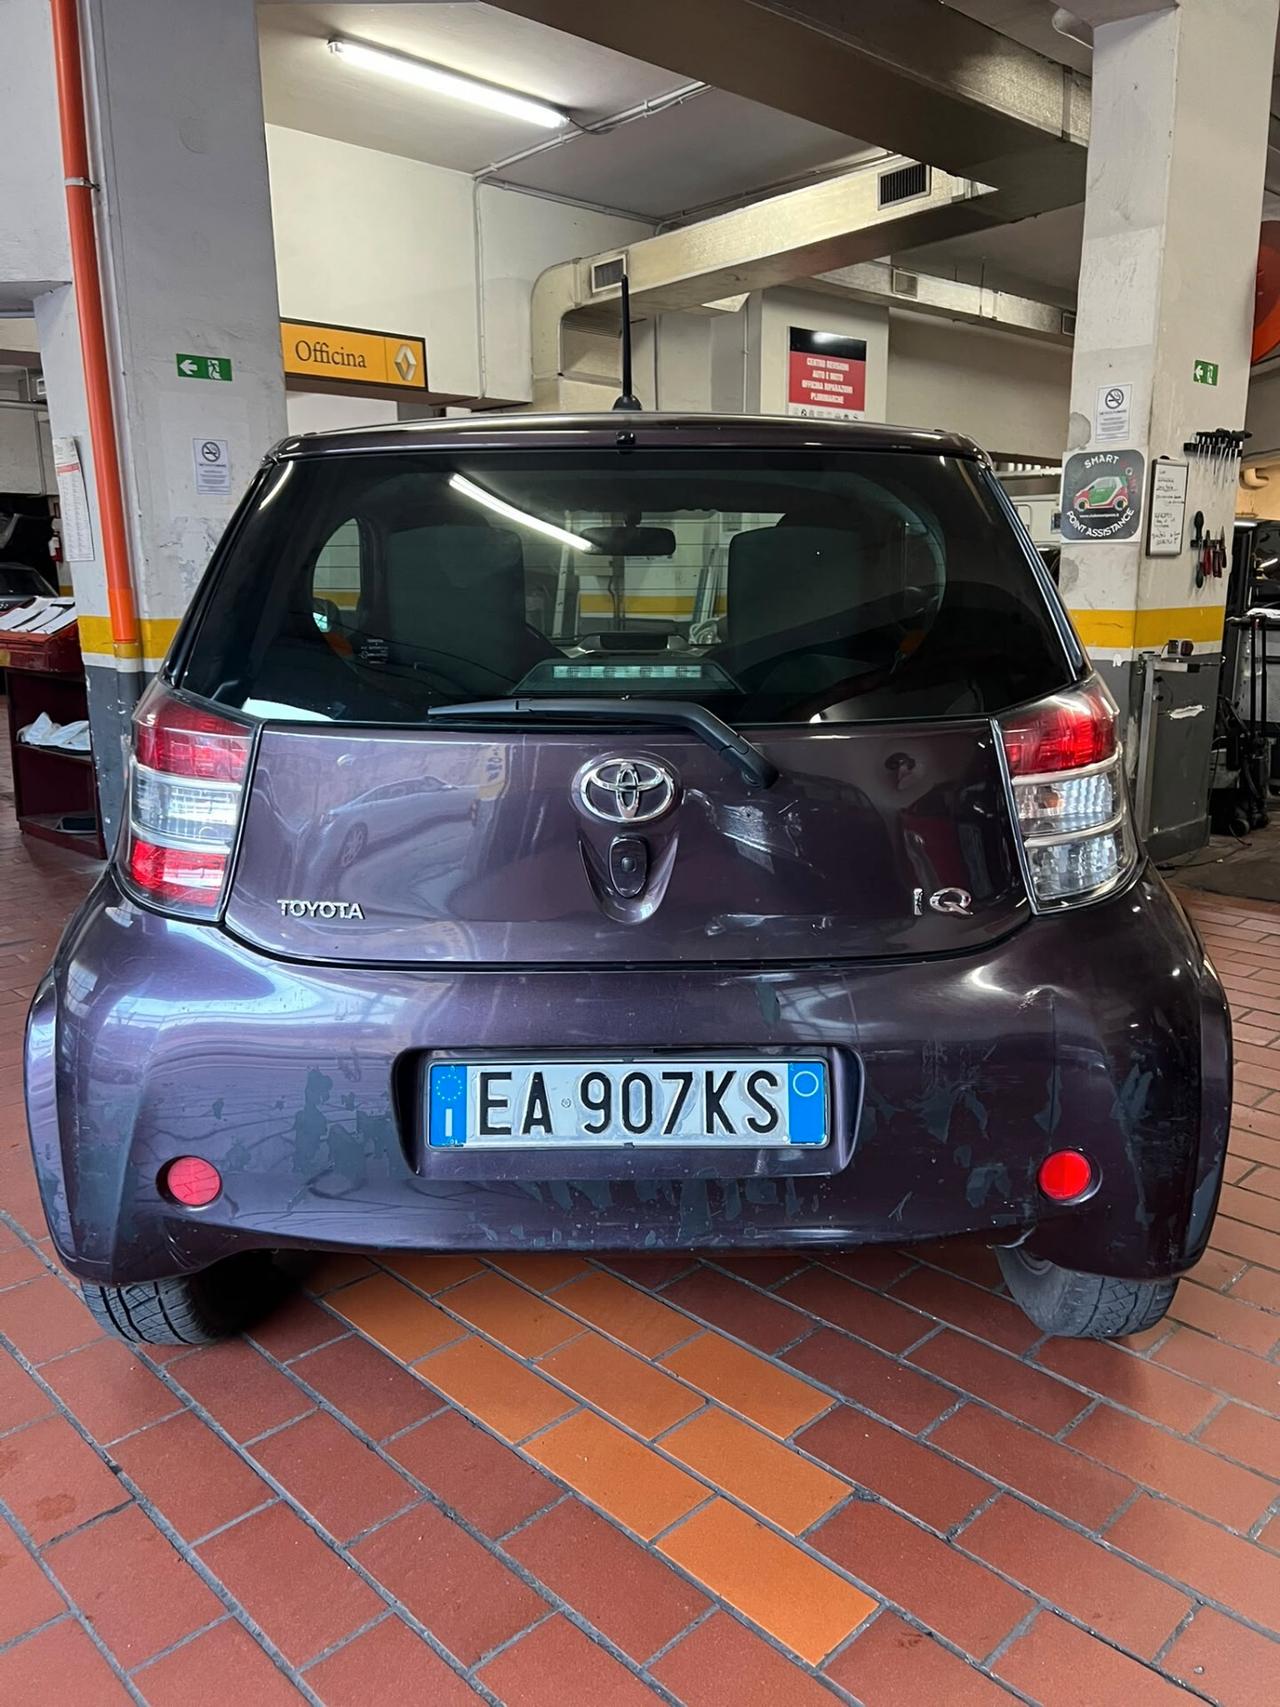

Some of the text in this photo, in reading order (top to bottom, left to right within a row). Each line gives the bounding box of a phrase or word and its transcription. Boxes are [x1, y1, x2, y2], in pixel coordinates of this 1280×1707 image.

[295, 340, 367, 368] Officina
[1084, 454, 1119, 469] SMART
[1066, 510, 1087, 533] POINT
[1085, 507, 1135, 537] ASSISTANCE
[277, 899, 365, 920] TOYOTA
[479, 1071, 554, 1136] EA
